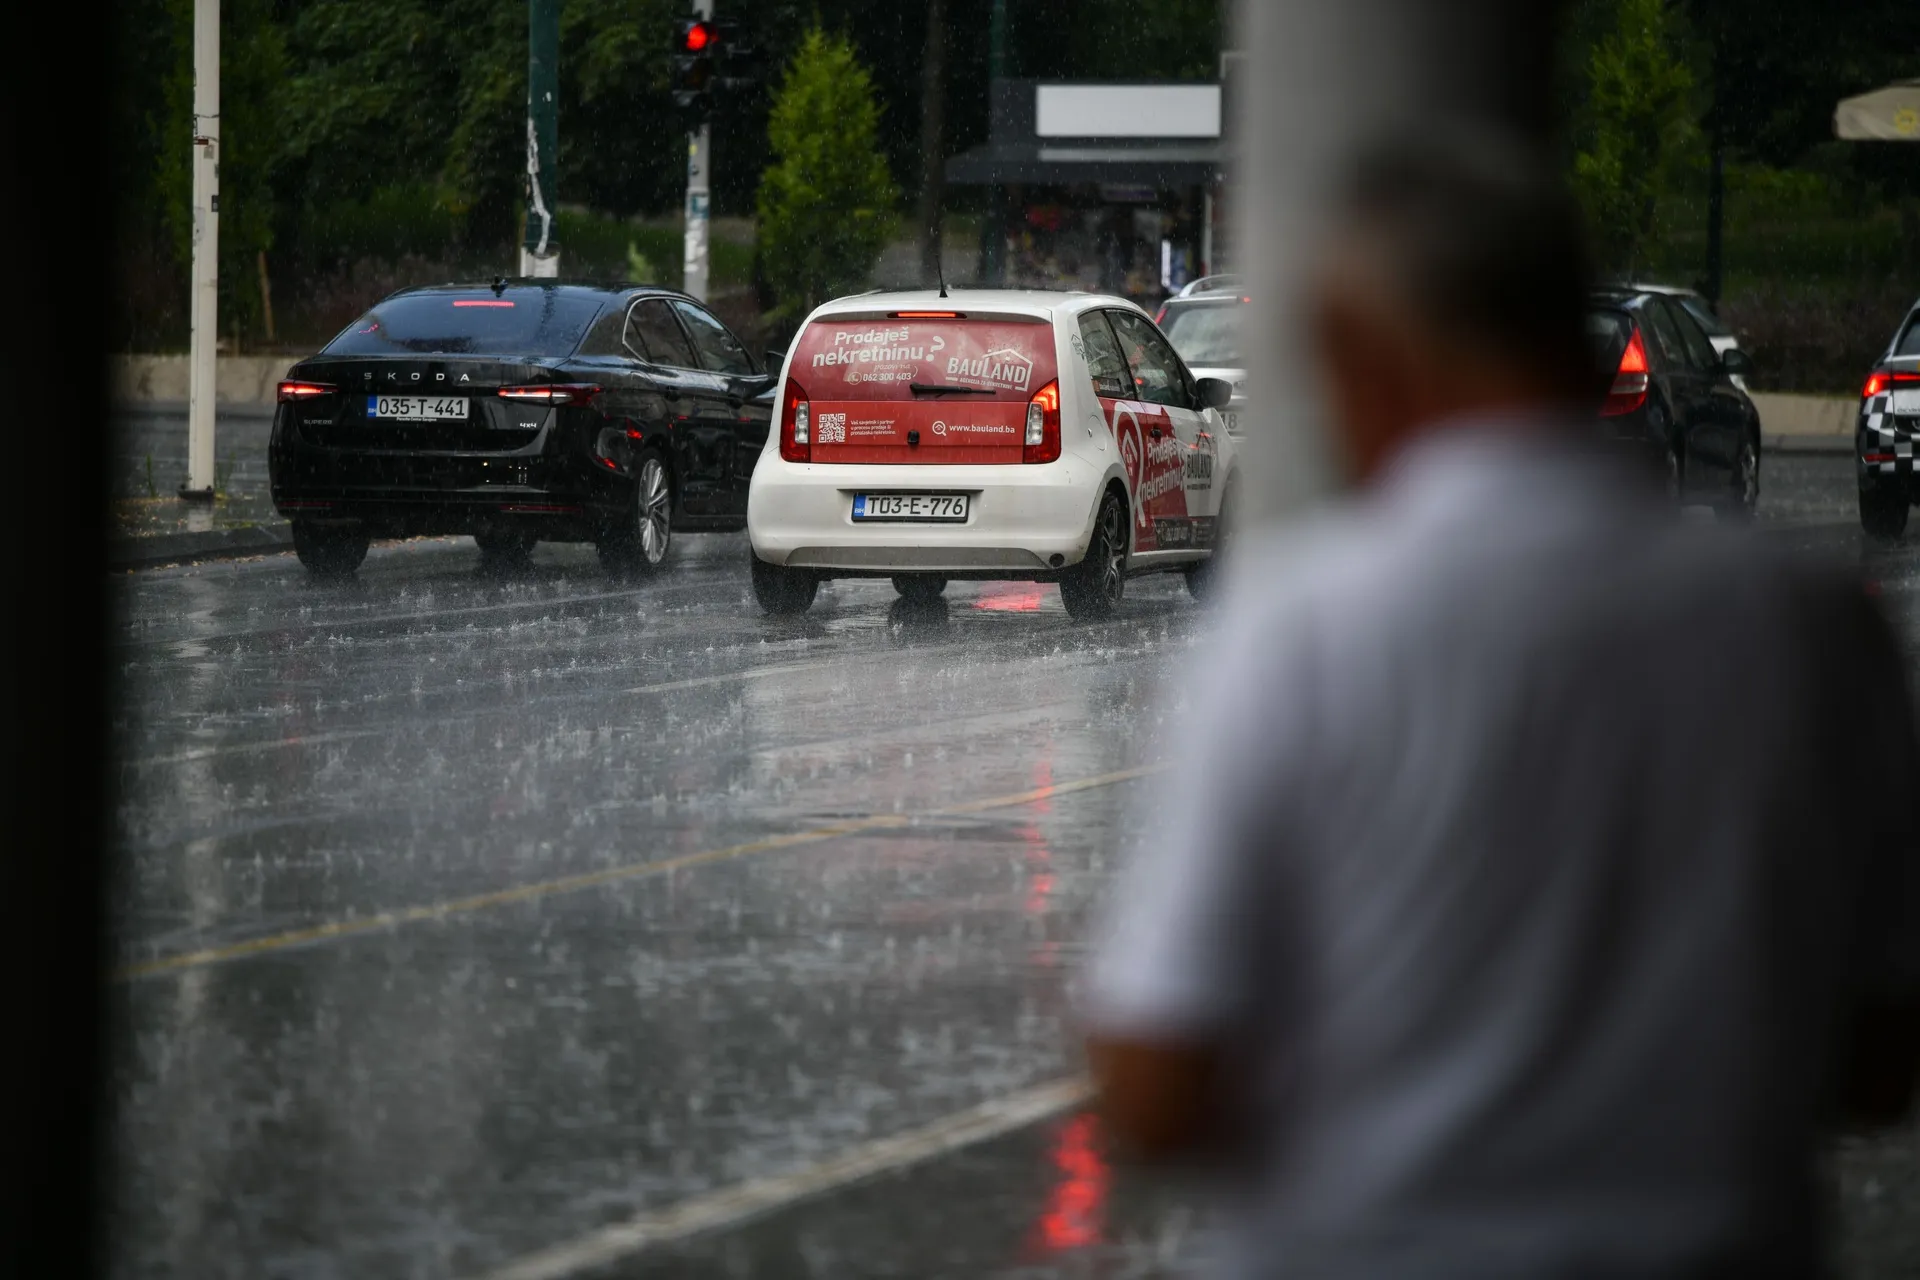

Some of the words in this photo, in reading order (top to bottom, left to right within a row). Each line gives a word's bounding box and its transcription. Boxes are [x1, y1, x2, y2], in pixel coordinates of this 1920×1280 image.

[834, 326, 909, 346] Prodaješ
[364, 372, 470, 381] SKODA
[863, 374, 878, 382] 062
[879, 373, 895, 381] 300
[947, 356, 1027, 384] BAULAND
[379, 398, 465, 416] 035-T-441
[949, 424, 1015, 434] www.bauland.ba
[868, 497, 963, 515] T03-E-776
